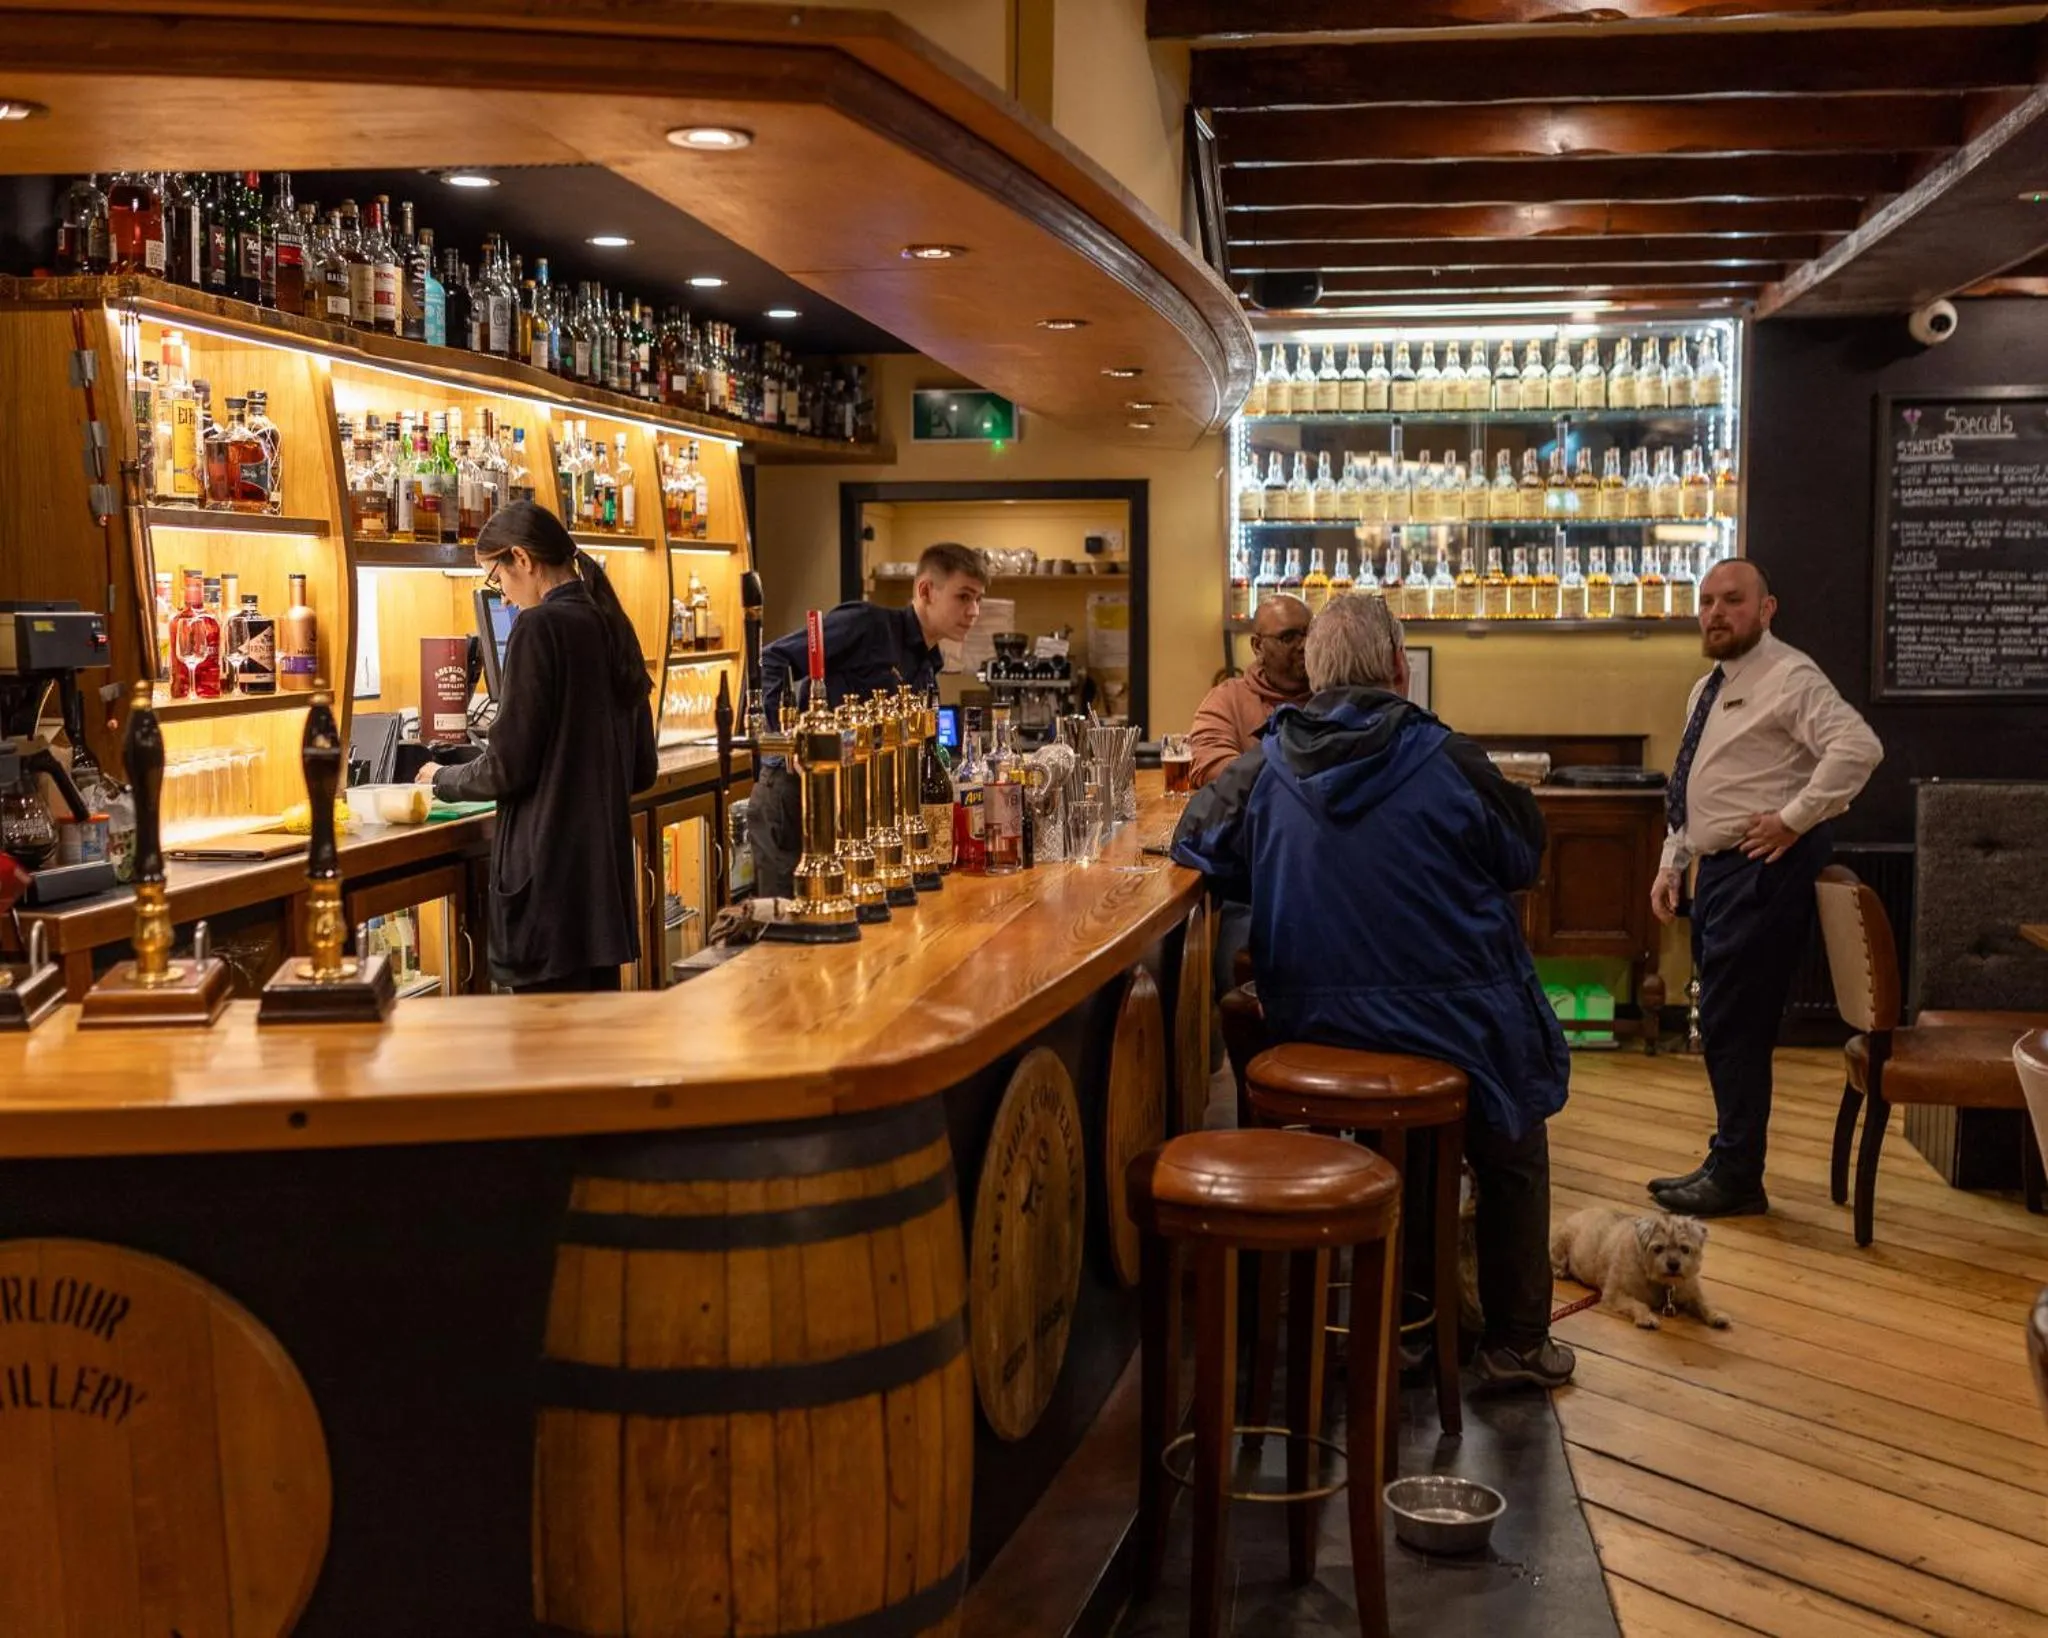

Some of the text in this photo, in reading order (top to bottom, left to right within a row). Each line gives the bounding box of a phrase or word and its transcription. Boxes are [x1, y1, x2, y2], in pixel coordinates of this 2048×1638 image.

[1945, 406, 2014, 436] Specials
[1896, 438, 1953, 457] STARTERS
[434, 666, 466, 680] ABERLO
[0, 1275, 131, 1342] RLOUR
[0, 1361, 149, 1425] ILLERY
